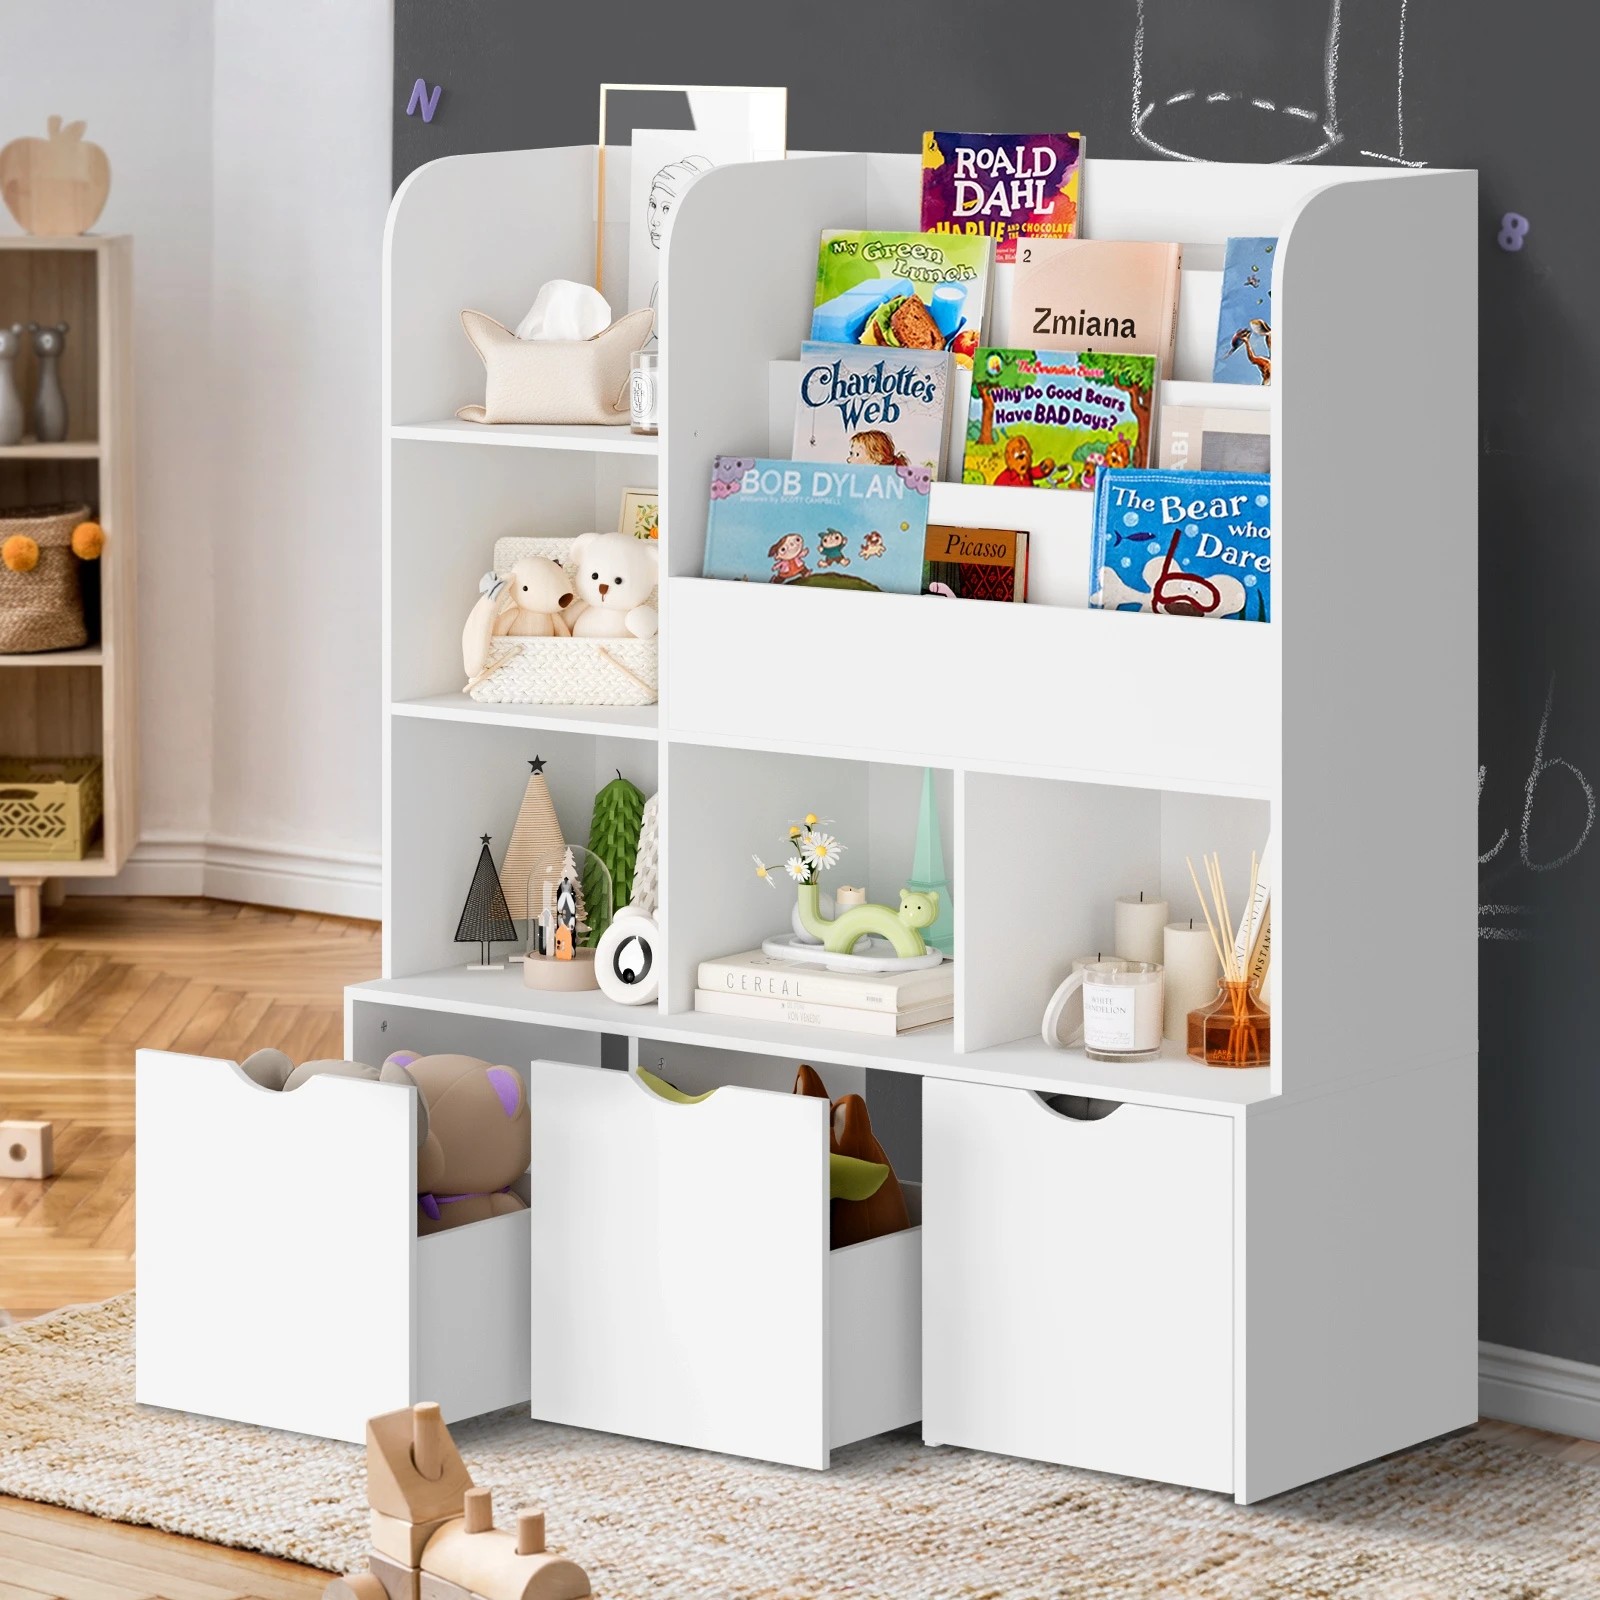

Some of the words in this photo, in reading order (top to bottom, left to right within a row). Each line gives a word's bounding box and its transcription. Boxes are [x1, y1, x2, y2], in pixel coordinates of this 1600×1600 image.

[406, 78, 441, 123] N
[953, 146, 1057, 179] ROALD
[952, 179, 1055, 217] DAHL
[1007, 223, 1020, 232] AND
[1021, 222, 1073, 233] CHOCOLATE
[1497, 212, 1529, 251] 8
[832, 240, 859, 255] My
[862, 240, 944, 265] Green
[1022, 249, 1032, 263] 2
[892, 258, 978, 283] Lunch
[1033, 307, 1137, 339] Zmiana
[800, 359, 937, 407] Charlotte's
[834, 393, 901, 433] Web
[990, 387, 1022, 404] Why
[1024, 384, 1044, 400] Do
[1046, 384, 1083, 400] Good
[1085, 387, 1126, 413] Bears
[995, 409, 1033, 425] Have
[1034, 403, 1071, 425] BAD
[1072, 408, 1118, 432] Days?
[740, 468, 801, 497] BOB
[811, 470, 905, 500] DYLAN
[1112, 485, 1155, 512] The
[1160, 495, 1248, 525] Bear
[1228, 521, 1271, 539] who
[944, 533, 1007, 559] Picasso
[726, 972, 802, 997] CEREAL
